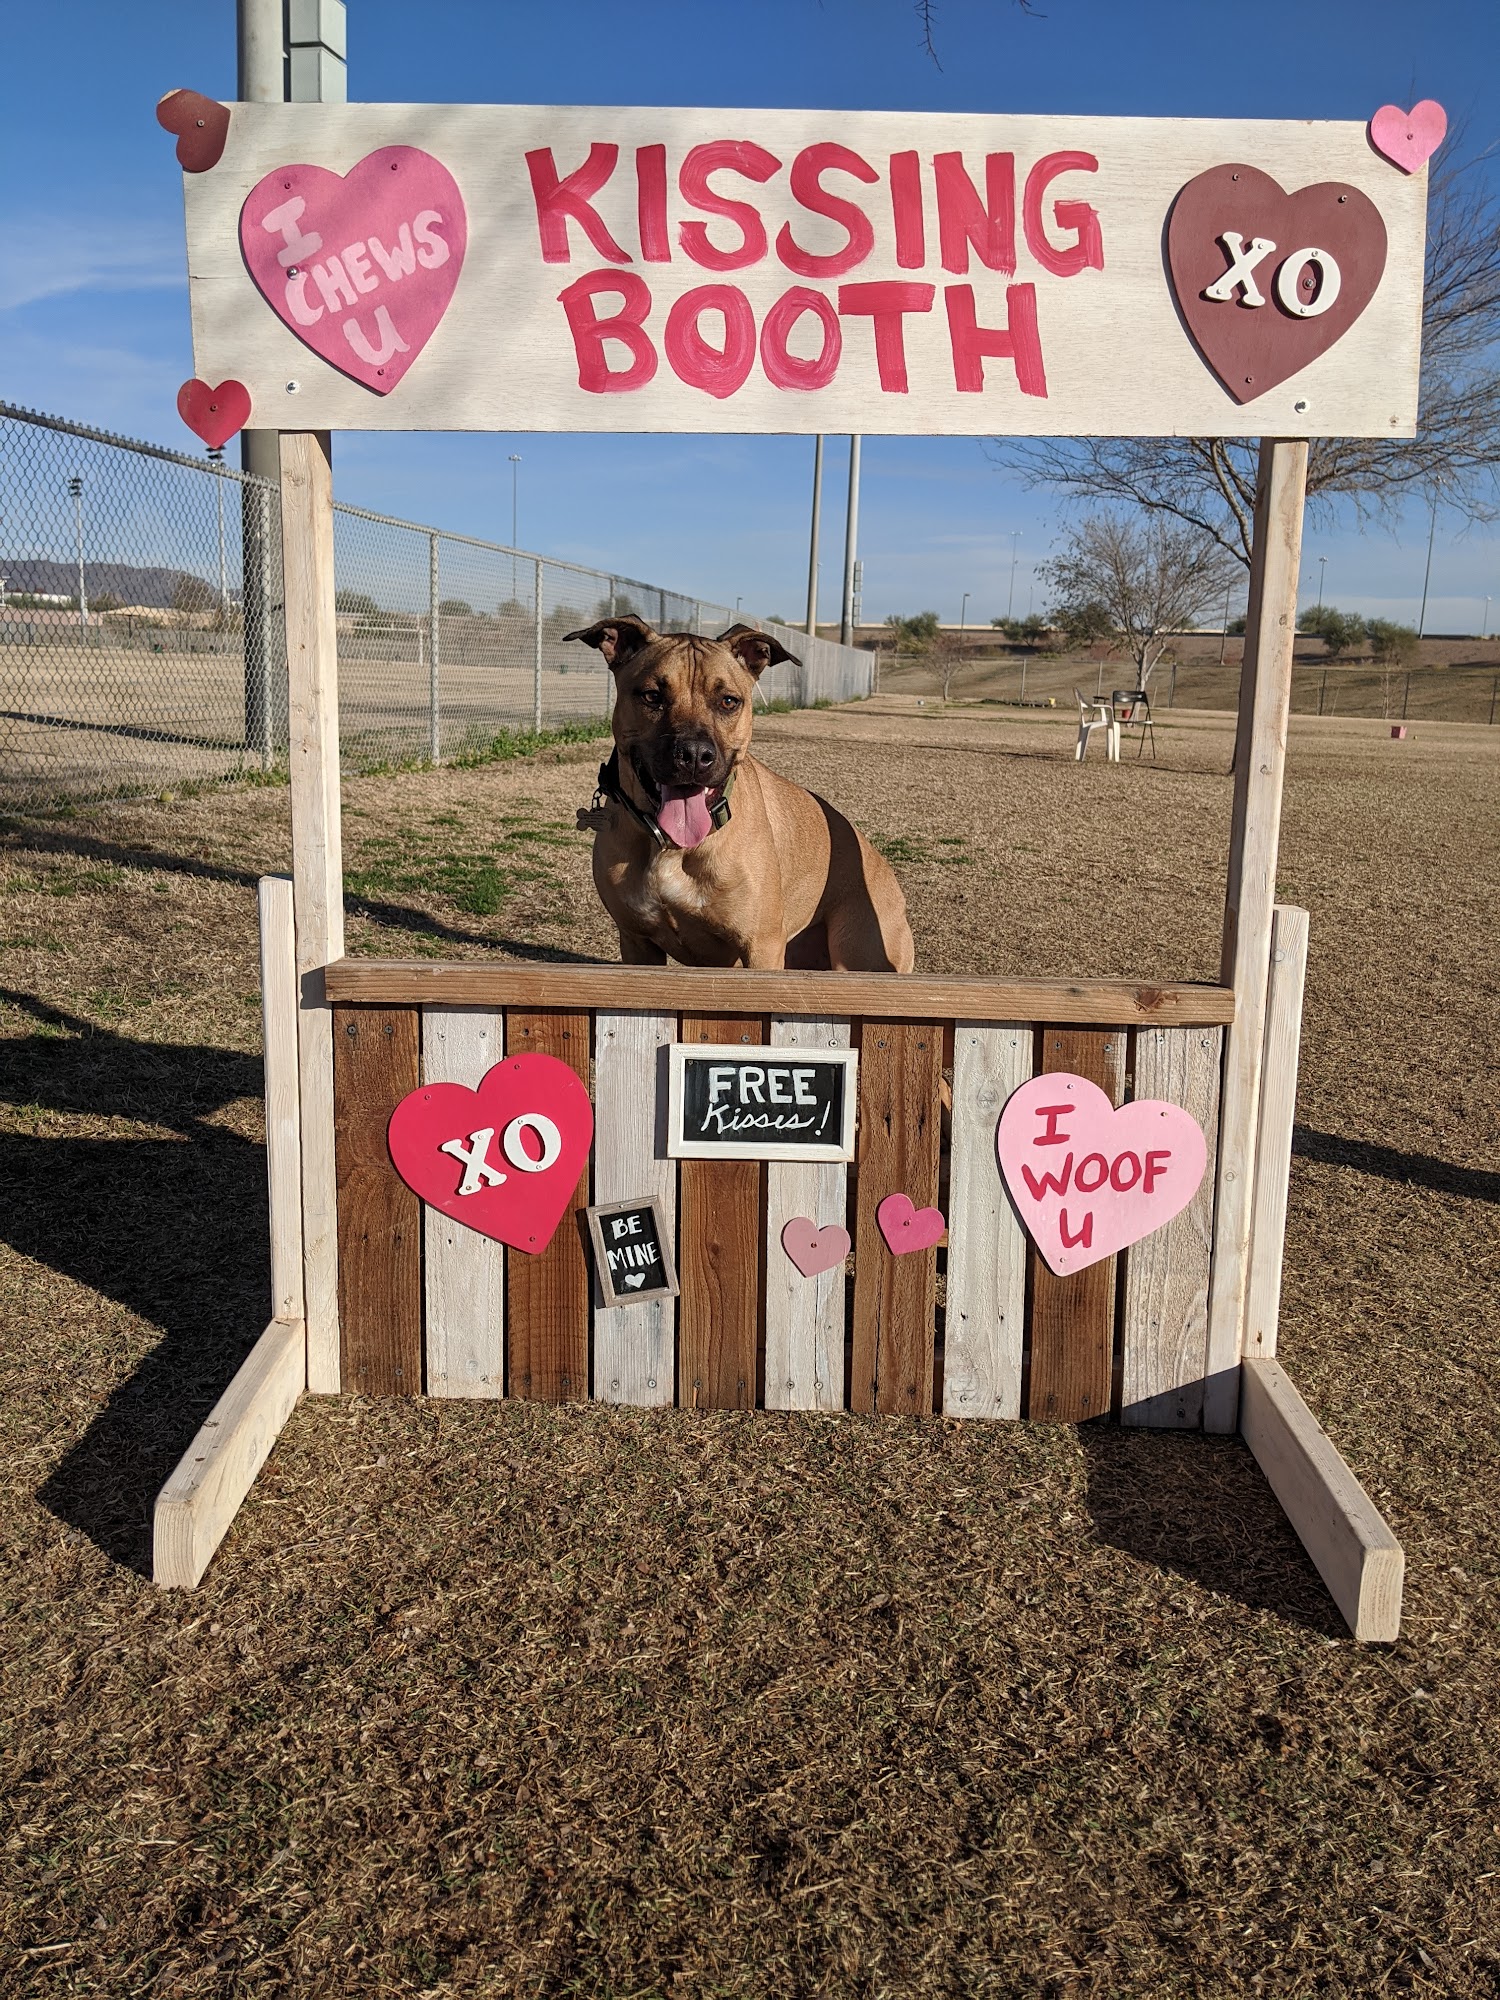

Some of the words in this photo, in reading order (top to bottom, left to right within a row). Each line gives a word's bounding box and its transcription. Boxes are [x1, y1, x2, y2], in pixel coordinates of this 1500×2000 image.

[262, 196, 323, 268] I
[525, 140, 1104, 278] KISSING
[285, 210, 450, 326] CHEWS
[1205, 231, 1341, 318] XO
[342, 305, 411, 366] U
[557, 268, 1049, 399] BOOTH
[709, 1066, 817, 1105] FREE
[701, 1101, 831, 1136] Kisses!
[1033, 1104, 1076, 1146] I
[441, 1113, 562, 1196] XO
[1020, 1150, 1172, 1202] WOOF
[610, 1215, 642, 1240] BE
[1059, 1208, 1093, 1249] U
[606, 1242, 660, 1270] MINE
